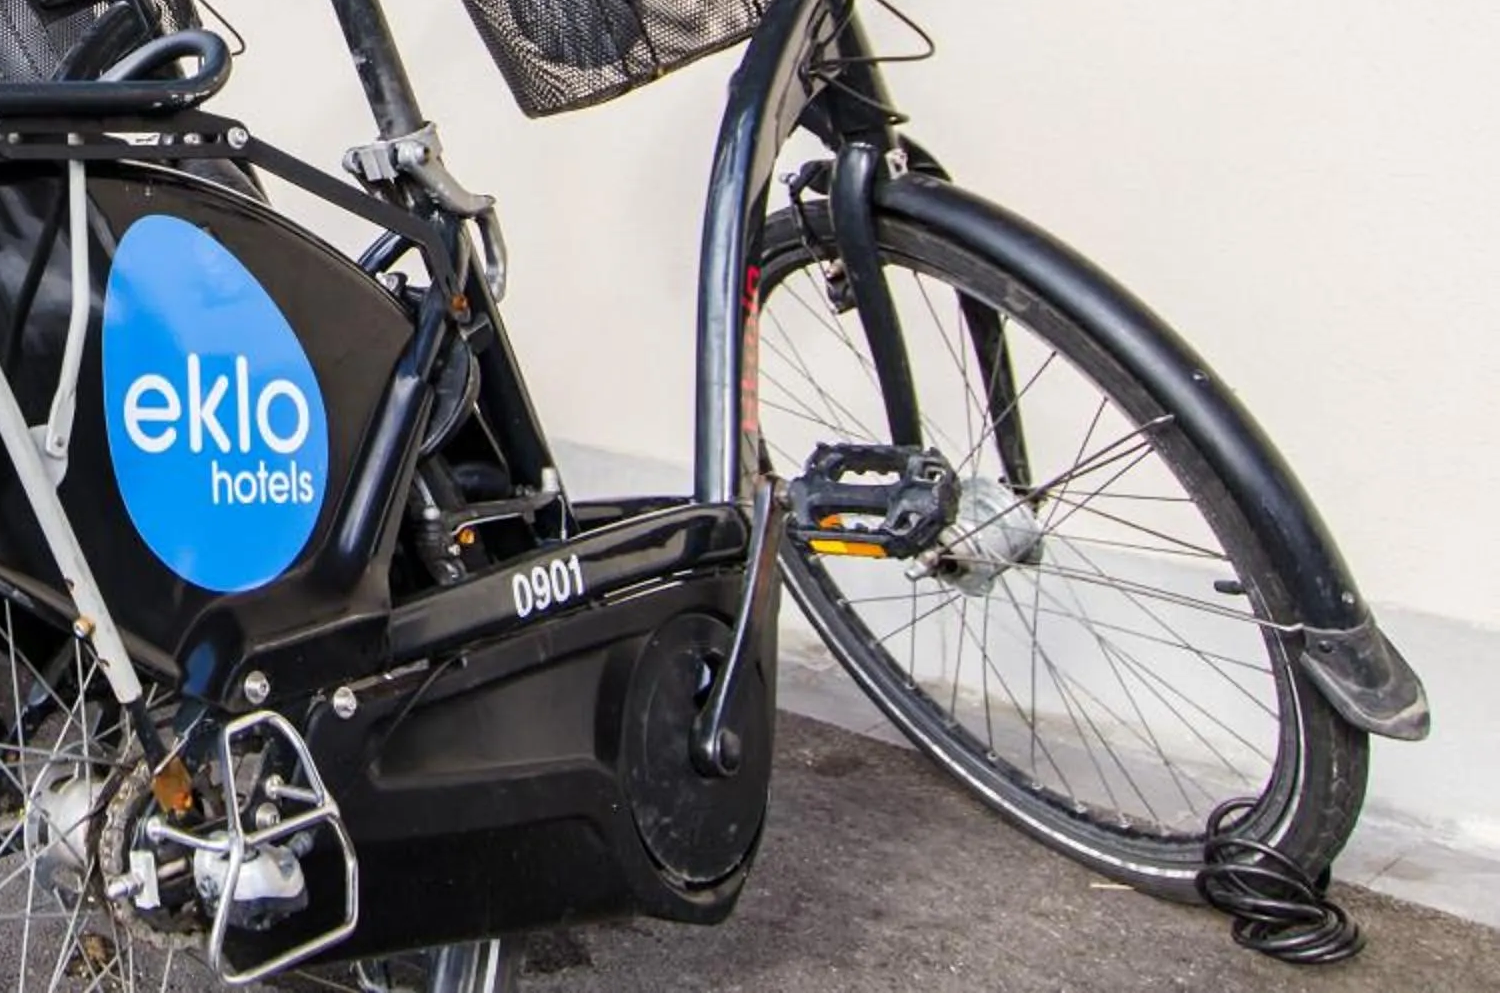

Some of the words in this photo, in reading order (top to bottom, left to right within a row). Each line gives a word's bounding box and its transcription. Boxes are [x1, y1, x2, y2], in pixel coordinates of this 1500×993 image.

[124, 352, 310, 454] eklo
[211, 461, 315, 504] hotels
[511, 553, 585, 618] 0901
